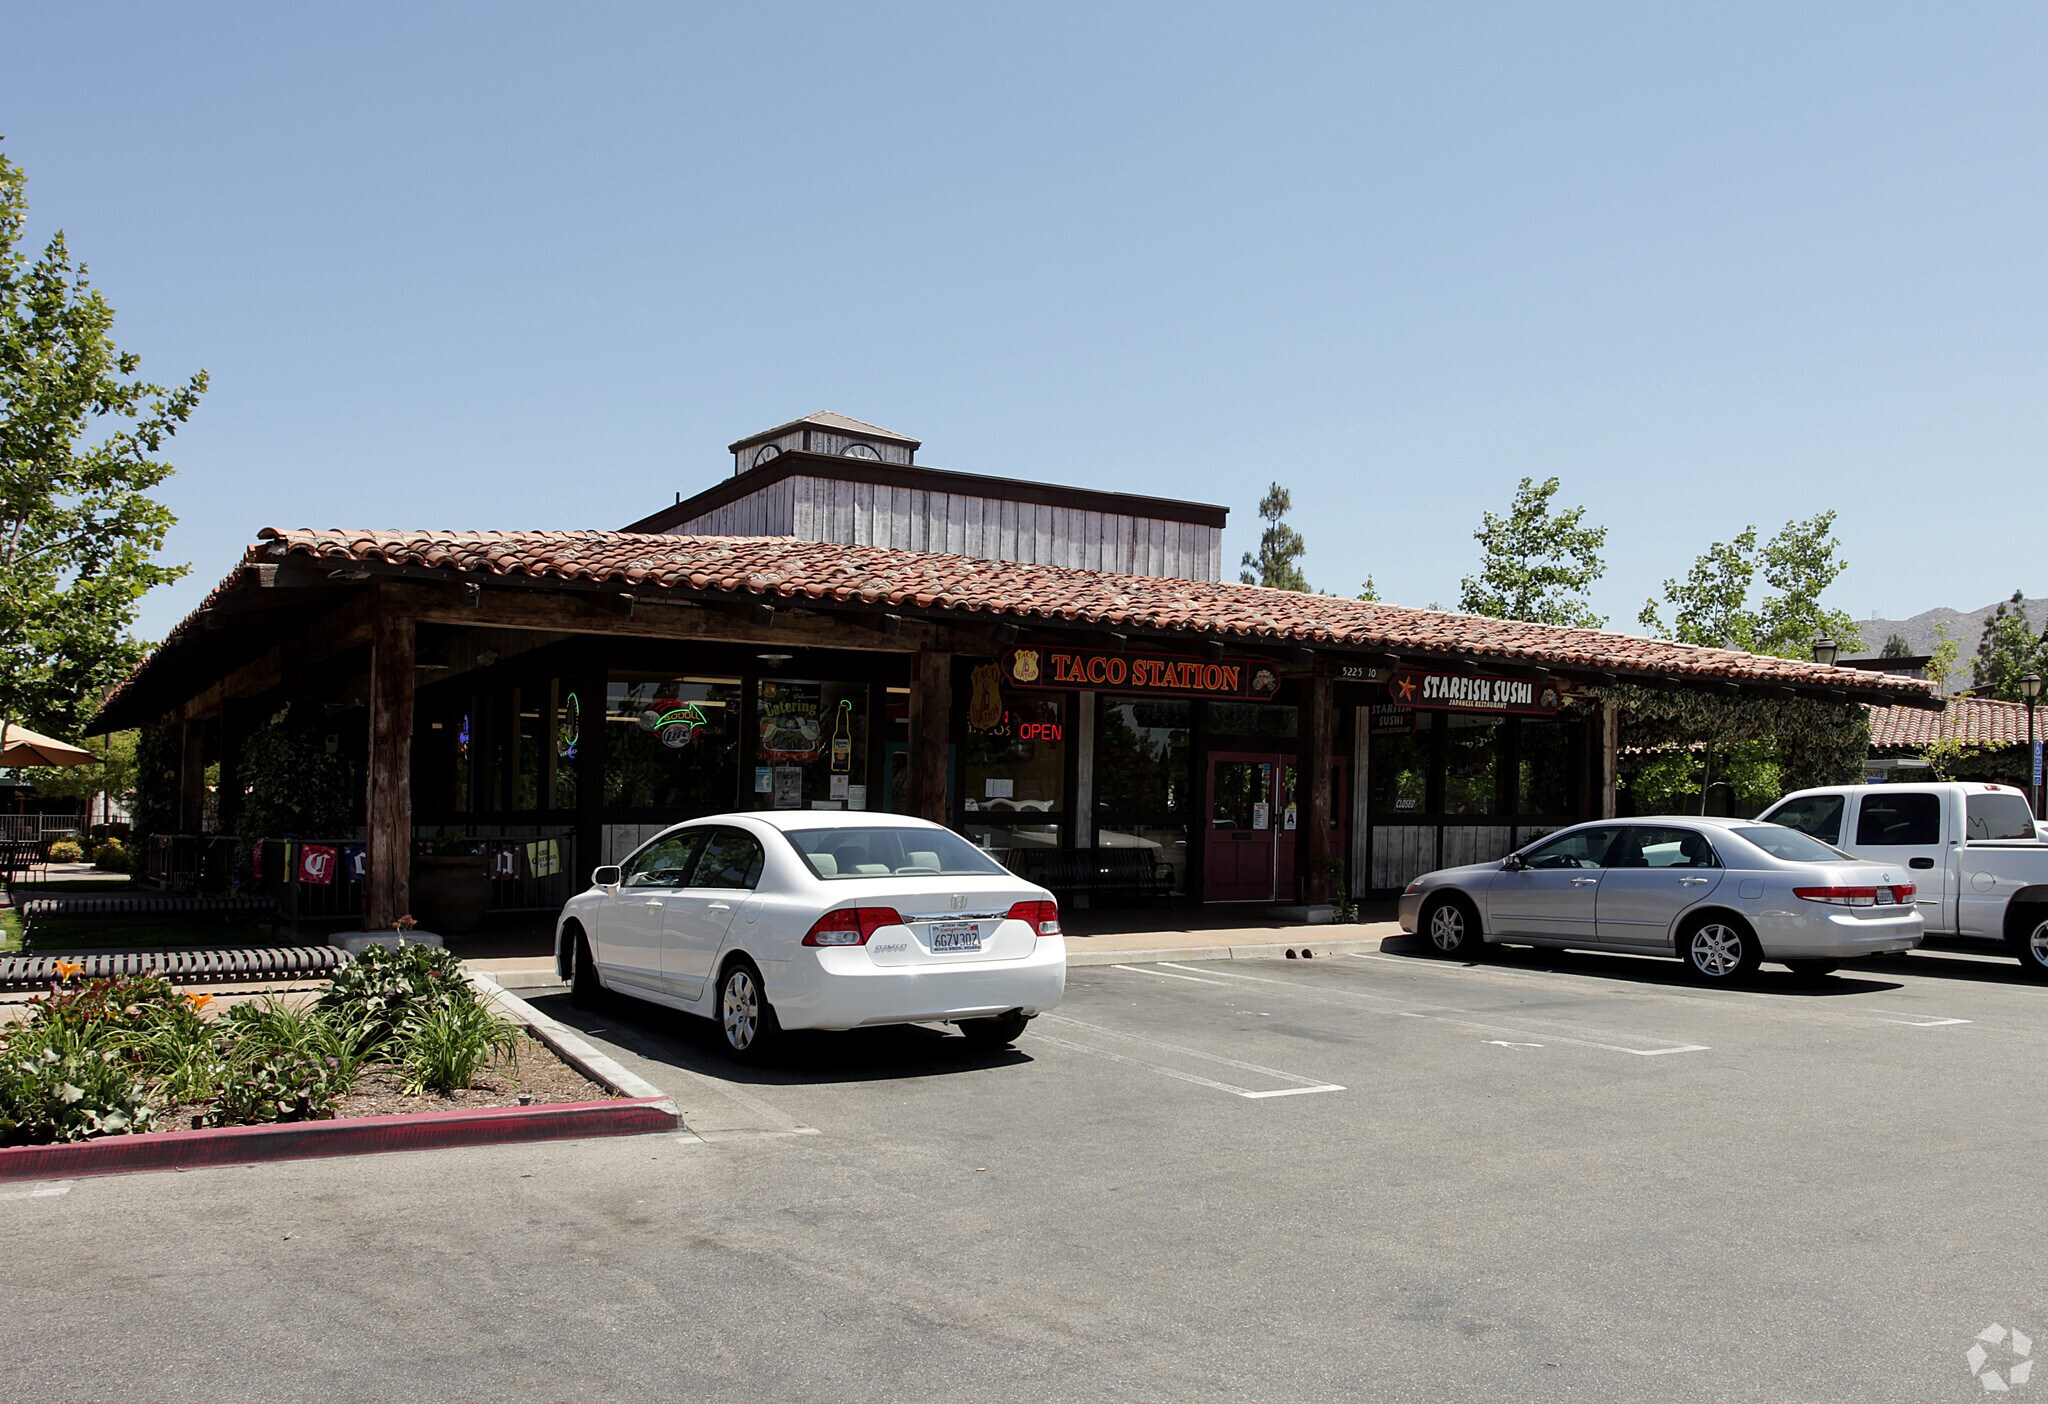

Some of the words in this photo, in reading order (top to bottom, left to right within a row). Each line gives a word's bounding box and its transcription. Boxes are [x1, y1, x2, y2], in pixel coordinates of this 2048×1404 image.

[1051, 653, 1128, 685] TACO
[1131, 659, 1241, 692] STATION
[1342, 666, 1363, 677] 5225
[1368, 668, 1377, 678] 10
[1422, 675, 1491, 701] STARFISH
[1493, 680, 1532, 704] SUSHI
[765, 699, 817, 717] Catering
[1449, 699, 1474, 708] JAPANESE
[1474, 700, 1508, 710] RESTAURANT
[1378, 715, 1404, 727] SUSHI
[1019, 723, 1063, 740] OPEN
[1287, 813, 1295, 824] A
[934, 933, 978, 947] 6GZV302
